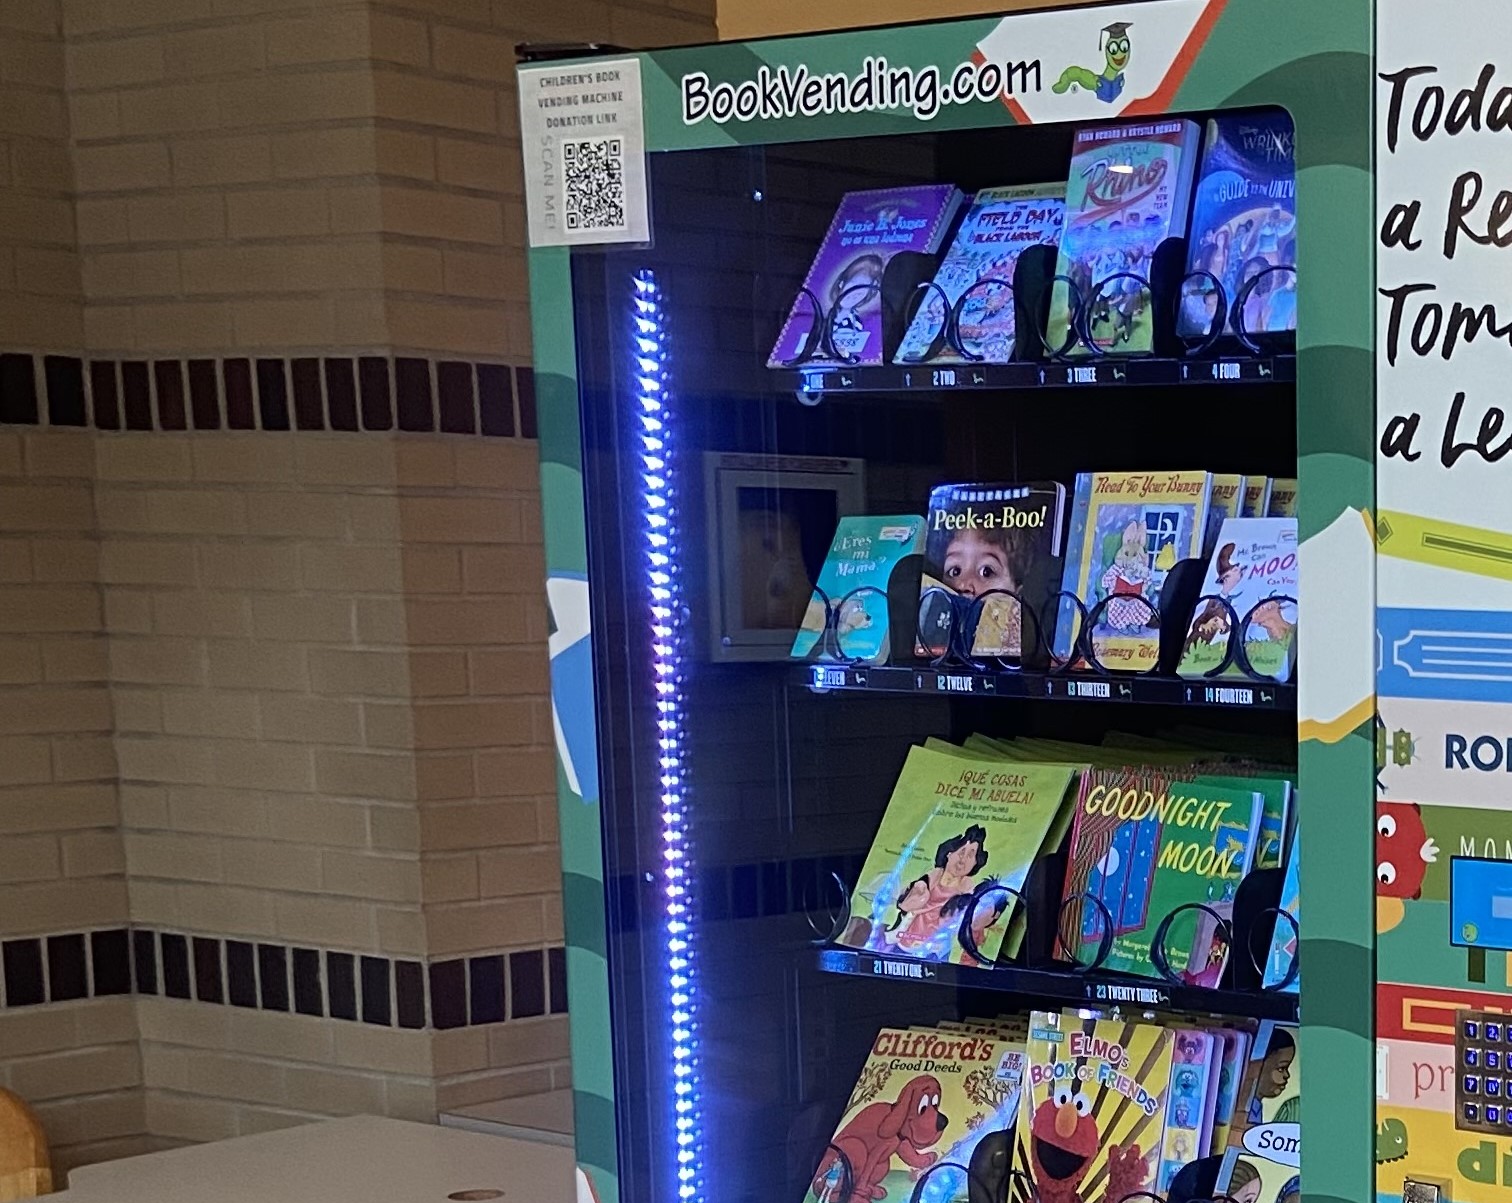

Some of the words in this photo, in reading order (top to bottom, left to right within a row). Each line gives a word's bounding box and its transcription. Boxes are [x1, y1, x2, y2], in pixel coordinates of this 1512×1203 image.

[540, 72, 593, 88] CHILDREN'S
[596, 70, 620, 83] BOOK
[683, 57, 1042, 121] BookVending.com
[538, 94, 579, 108] VENDING
[582, 91, 623, 104] MACHINE
[546, 114, 594, 128] DONATION
[596, 112, 617, 124] LINK
[540, 134, 554, 187] SCAN
[1380, 200, 1422, 251] a
[1219, 362, 1241, 379] FOUR
[1380, 411, 1422, 460] a
[1095, 477, 1126, 494] Read
[1127, 475, 1139, 494] To
[1140, 476, 1163, 498] Your
[1166, 474, 1203, 496] Bunny
[933, 505, 1048, 531] Peek-a-Boo!
[946, 675, 973, 691] TWELVE
[1077, 682, 1110, 698] THIRTEEN
[1215, 688, 1253, 704] FOURTEEN
[990, 773, 1028, 788] COSAS
[935, 782, 967, 799] DICE
[1085, 784, 1232, 833] GOODNIGHT
[1158, 840, 1239, 880] MOON
[884, 960, 909, 977] TWENTY
[1097, 984, 1106, 999] 23
[1108, 985, 1136, 1002] TWENTY
[1136, 988, 1158, 1004] THREE
[872, 1032, 995, 1062] Clifford's
[890, 1058, 922, 1072] Good
[923, 1060, 963, 1073] Deeds
[1031, 1061, 1077, 1087] BOOK
[1077, 1065, 1094, 1081] OF
[1097, 1062, 1159, 1116] FRIENDS
